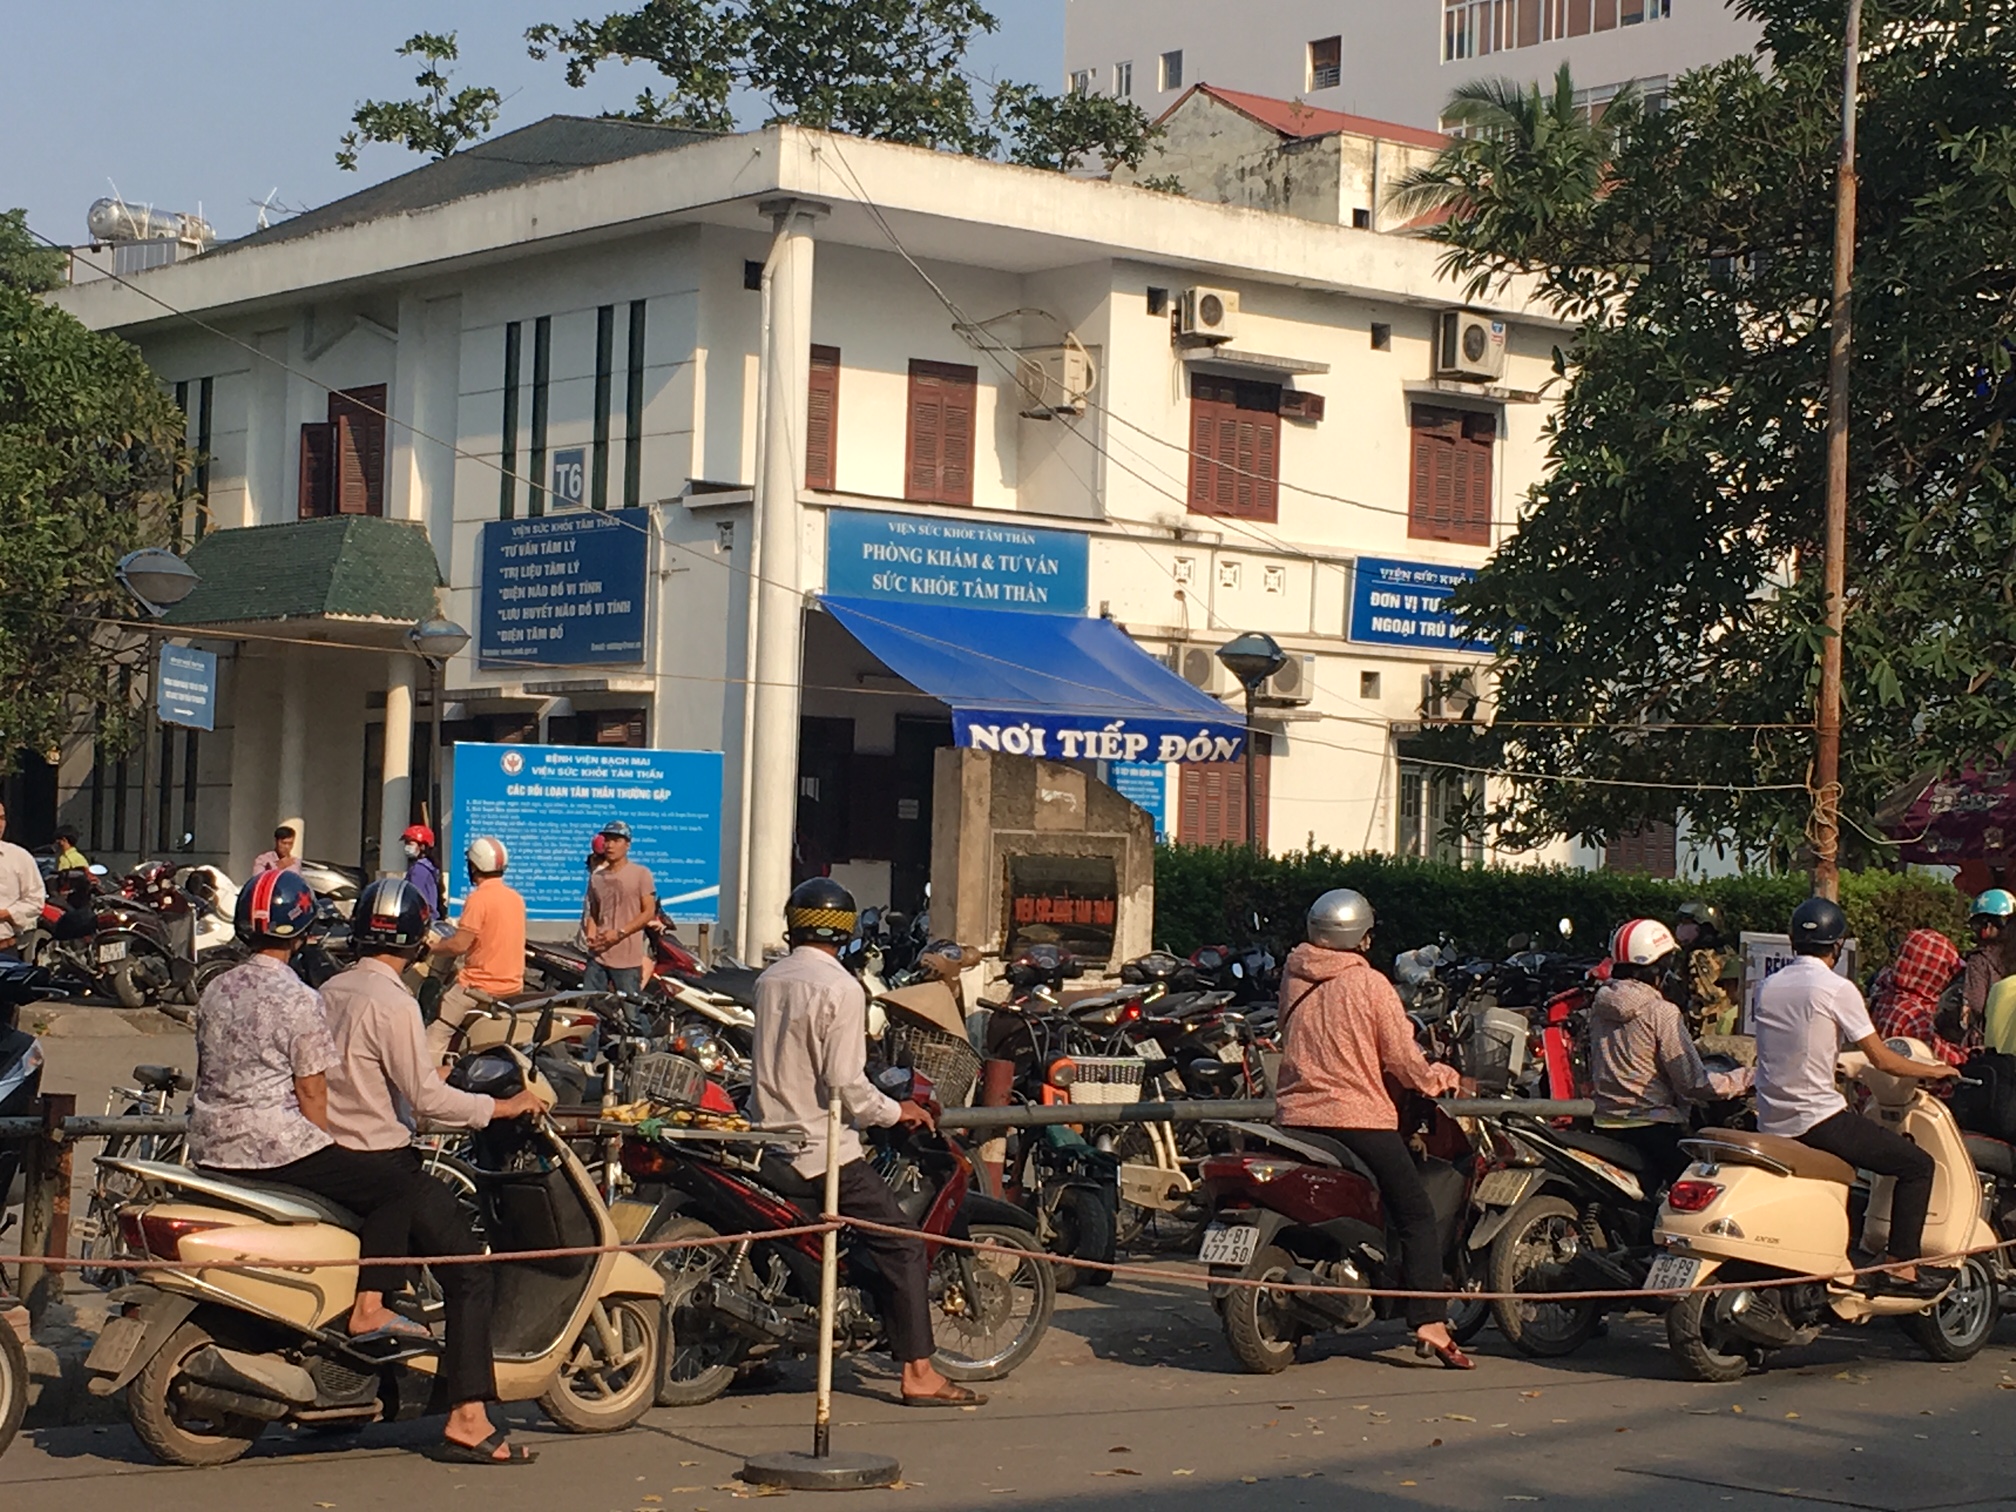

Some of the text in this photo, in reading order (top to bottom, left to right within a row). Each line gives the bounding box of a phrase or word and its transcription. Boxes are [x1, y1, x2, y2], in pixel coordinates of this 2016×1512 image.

[555, 463, 582, 499] T6
[888, 522, 916, 535] VIỆN
[918, 521, 941, 537] SỨC
[943, 524, 976, 540] KHỎE
[978, 529, 1003, 543] TÂM
[541, 540, 561, 554] TÂM
[564, 537, 576, 552] LÝ
[862, 540, 923, 564] PHÒNG
[926, 546, 978, 569] KHÁM
[981, 555, 994, 570] &
[998, 553, 1023, 572] TƯ
[544, 561, 566, 576] TÂM
[567, 559, 580, 574] LÝ
[872, 570, 1048, 603] SỨC KHỎE TÂM THẦN
[1370, 592, 1401, 608] ĐƠN
[1404, 595, 1418, 613] VỊ
[1421, 596, 1441, 612] TƯ
[527, 627, 547, 640] TÂM
[1371, 616, 1416, 637] NGOẠI
[1419, 619, 1446, 637] TRÚ
[968, 720, 1242, 762] NƠI TIẾP ĐÓN
[545, 753, 651, 768] BỆNH VIỆN BẠCH MAI
[531, 766, 555, 777] VIỆN
[557, 766, 579, 777] SỨC
[581, 766, 608, 778] KHỎE
[611, 768, 633, 778] TÂM
[507, 783, 525, 797] CÁC
[545, 785, 569, 799] LOẠN
[570, 784, 589, 798] TÂM
[1202, 1244, 1249, 1263] 477.50
